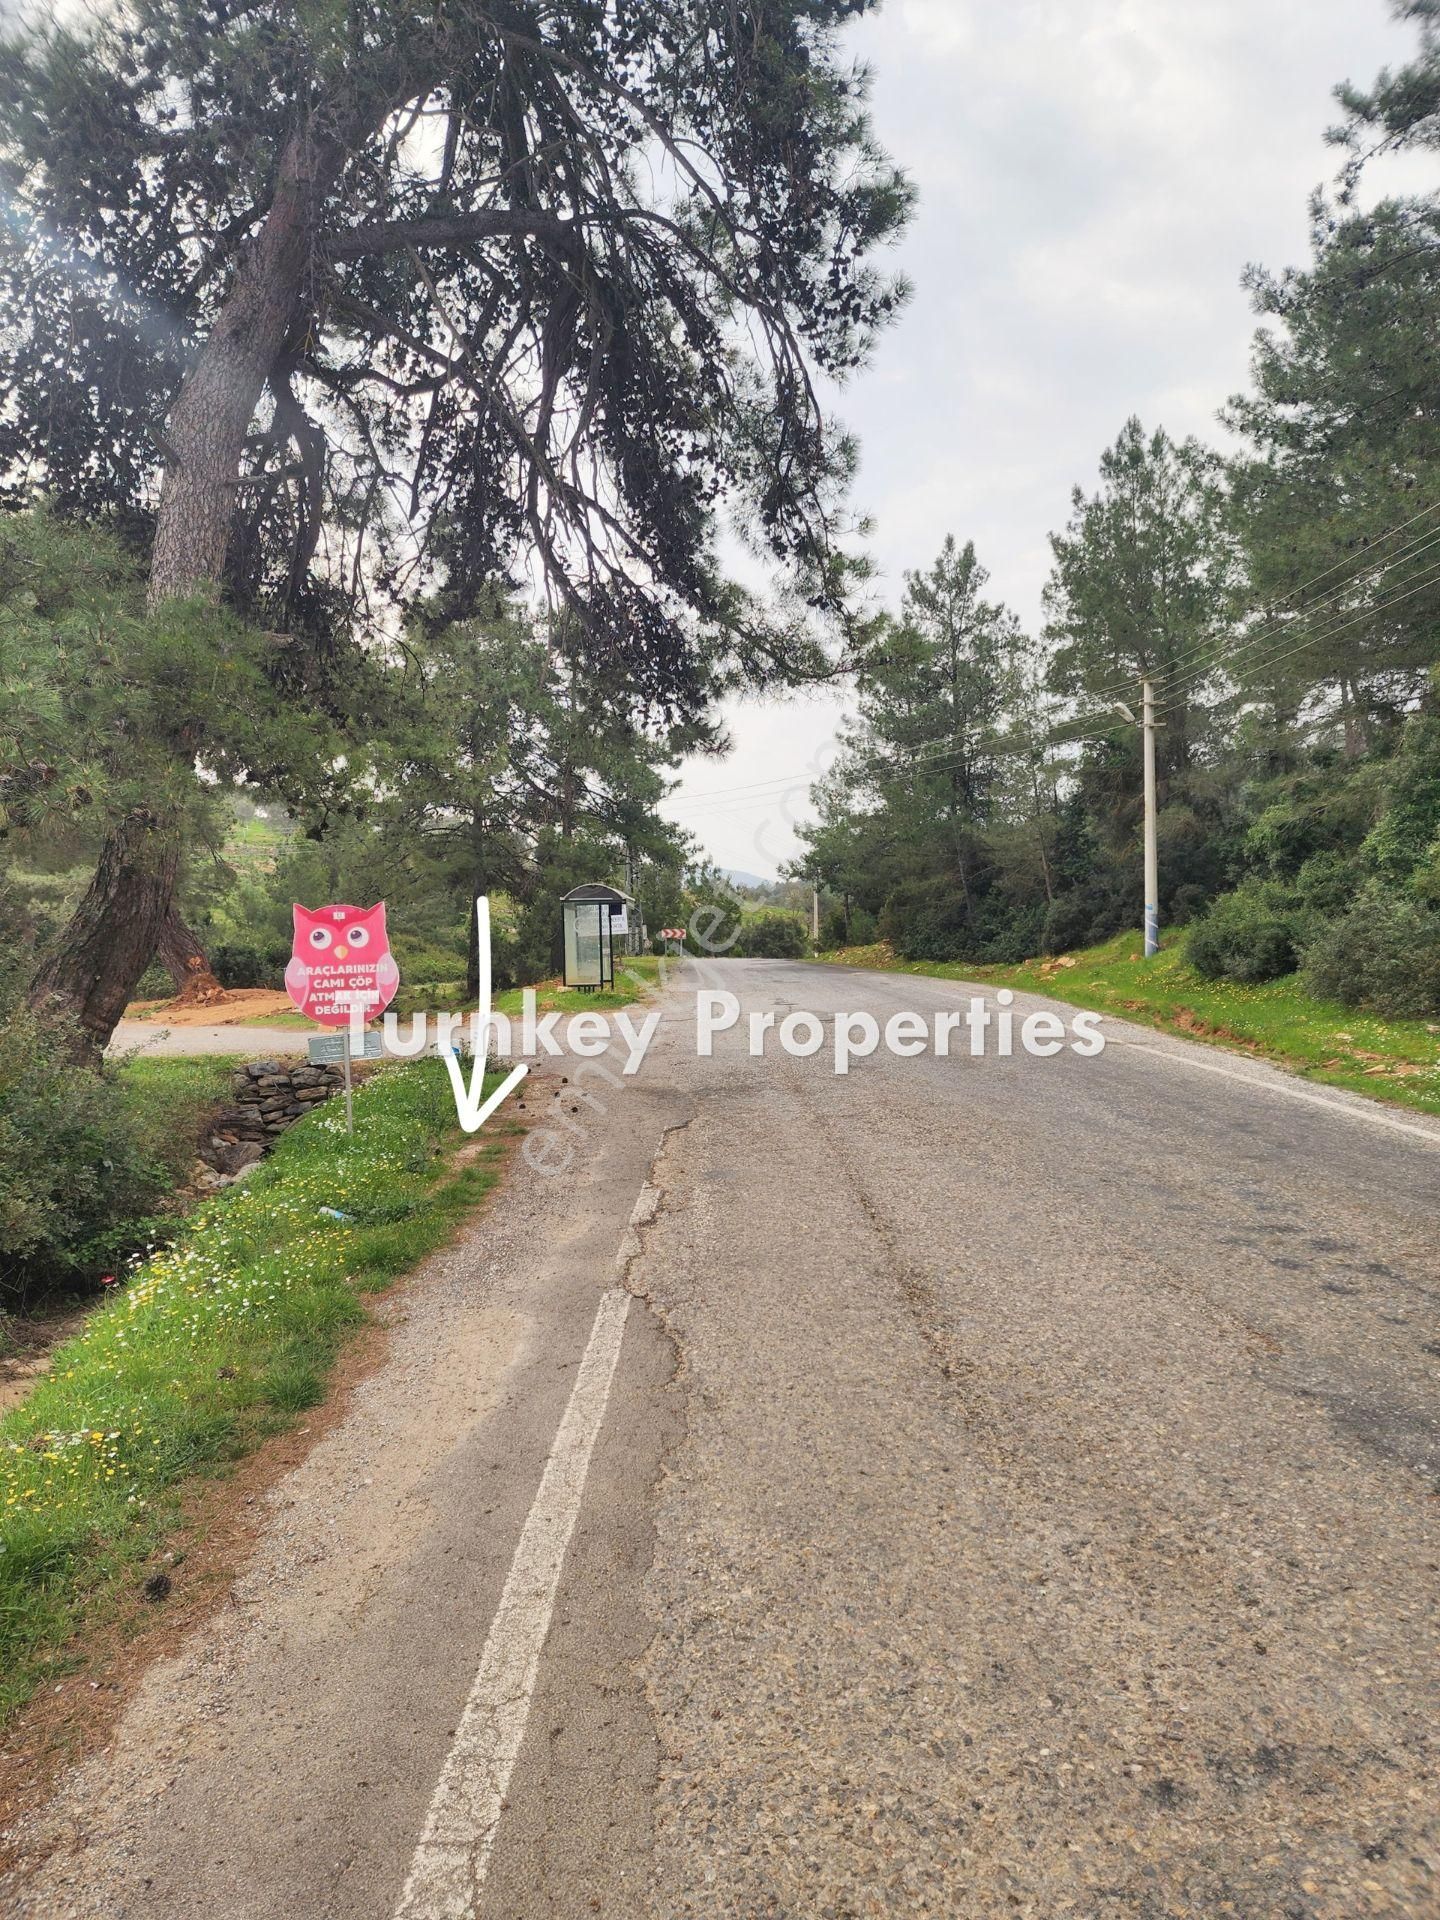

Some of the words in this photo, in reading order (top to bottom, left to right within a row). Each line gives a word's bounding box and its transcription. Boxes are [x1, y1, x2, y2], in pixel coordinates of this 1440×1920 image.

[297, 963, 388, 976] ARAÇLARINIZIN
[313, 978, 345, 988] CAMI
[348, 975, 373, 989] ÇÖP
[309, 991, 350, 1002] ATMAK
